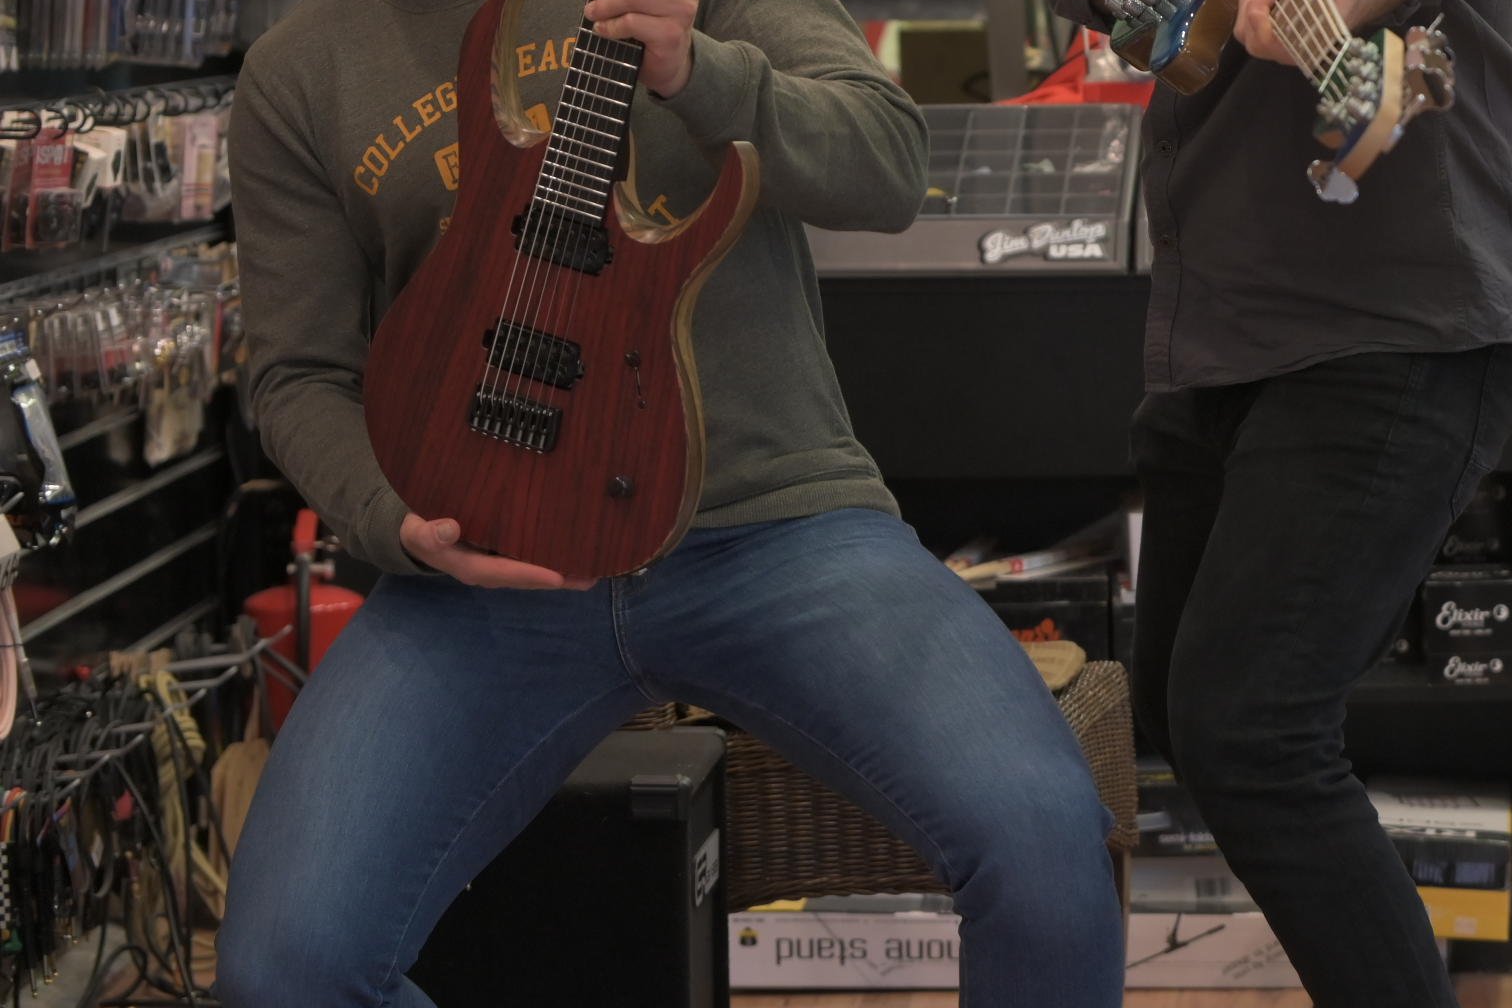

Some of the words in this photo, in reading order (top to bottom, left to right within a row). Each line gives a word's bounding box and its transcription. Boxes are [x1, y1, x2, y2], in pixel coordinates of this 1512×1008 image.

[353, 76, 459, 197] COLLEG
[983, 232, 1029, 263] Jim
[1029, 219, 1106, 251] Dunlop
[1049, 243, 1103, 258] USA
[1435, 600, 1490, 631] Elixir
[1443, 655, 1489, 681] Elixir
[775, 936, 868, 966] stand
